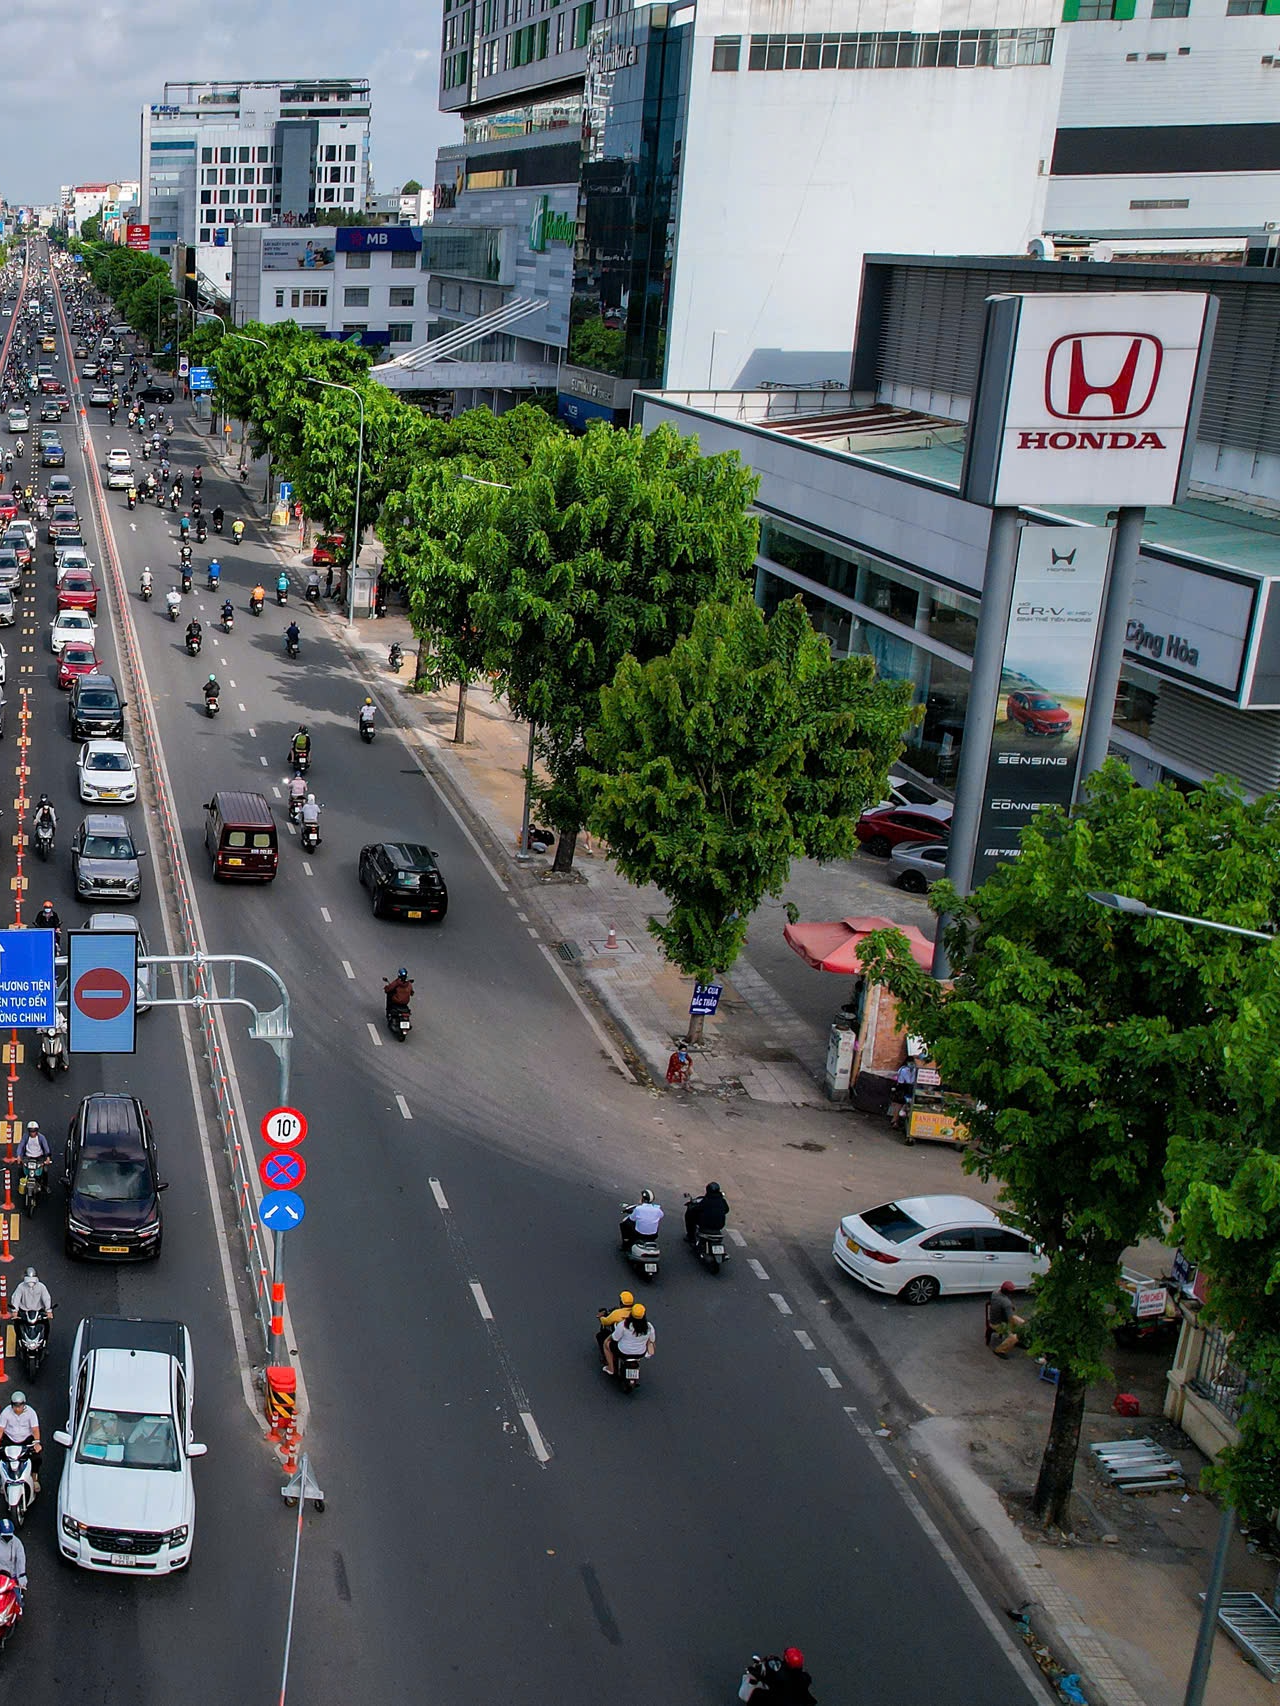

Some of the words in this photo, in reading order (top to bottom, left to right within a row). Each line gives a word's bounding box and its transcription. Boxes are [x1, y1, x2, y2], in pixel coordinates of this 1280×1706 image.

[367, 233, 388, 245] MB
[1017, 432, 1166, 450] HONDA
[1016, 606, 1065, 616] CR-V
[1126, 619, 1164, 658] Cộng
[1166, 634, 1198, 667] Hòa
[998, 756, 1068, 765] SENSING
[991, 802, 1060, 810] CONNET
[31, 979, 51, 993] TIỆN
[696, 985, 708, 993] SP
[11, 997, 27, 1011] TỤC
[28, 992, 47, 1007] ĐẾN
[20, 1012, 47, 1023] CHINH
